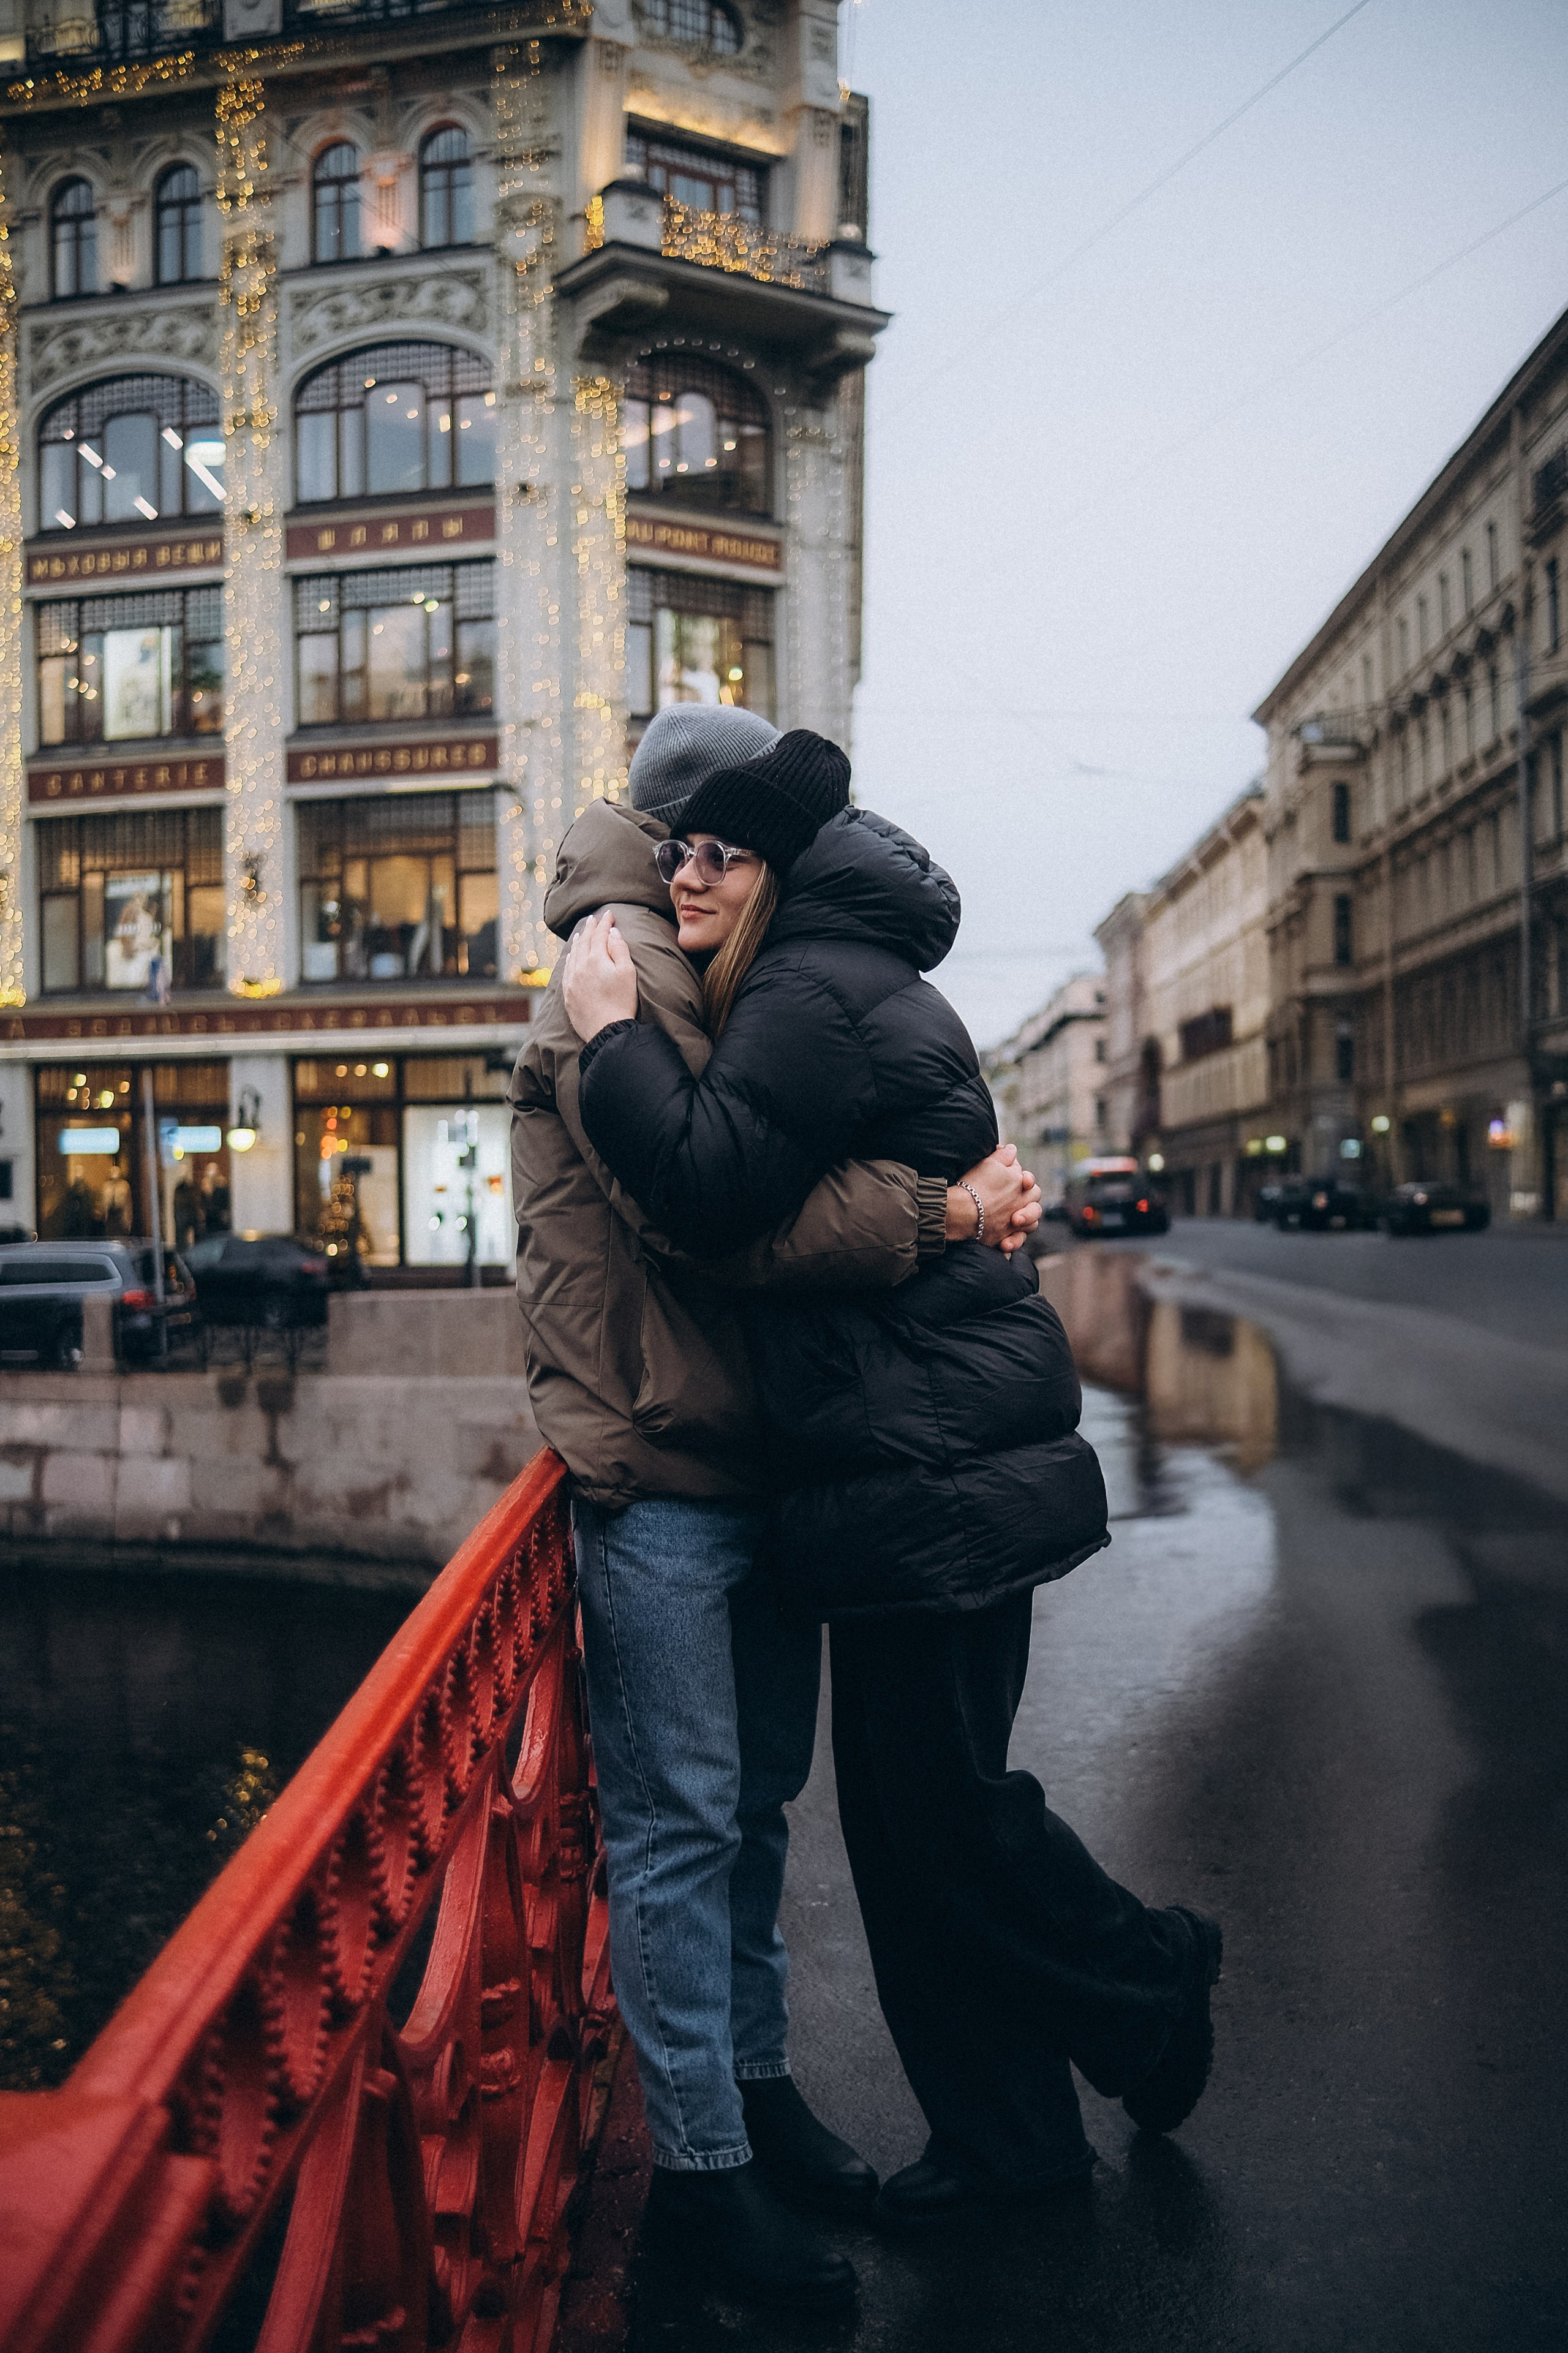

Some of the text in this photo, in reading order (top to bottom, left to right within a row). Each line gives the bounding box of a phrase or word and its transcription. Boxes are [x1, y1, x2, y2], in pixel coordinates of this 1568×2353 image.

[318, 516, 463, 550] ШЛЯПЫ
[156, 540, 221, 567] ВЕЩИ
[300, 743, 487, 777] CHAUSSURES
